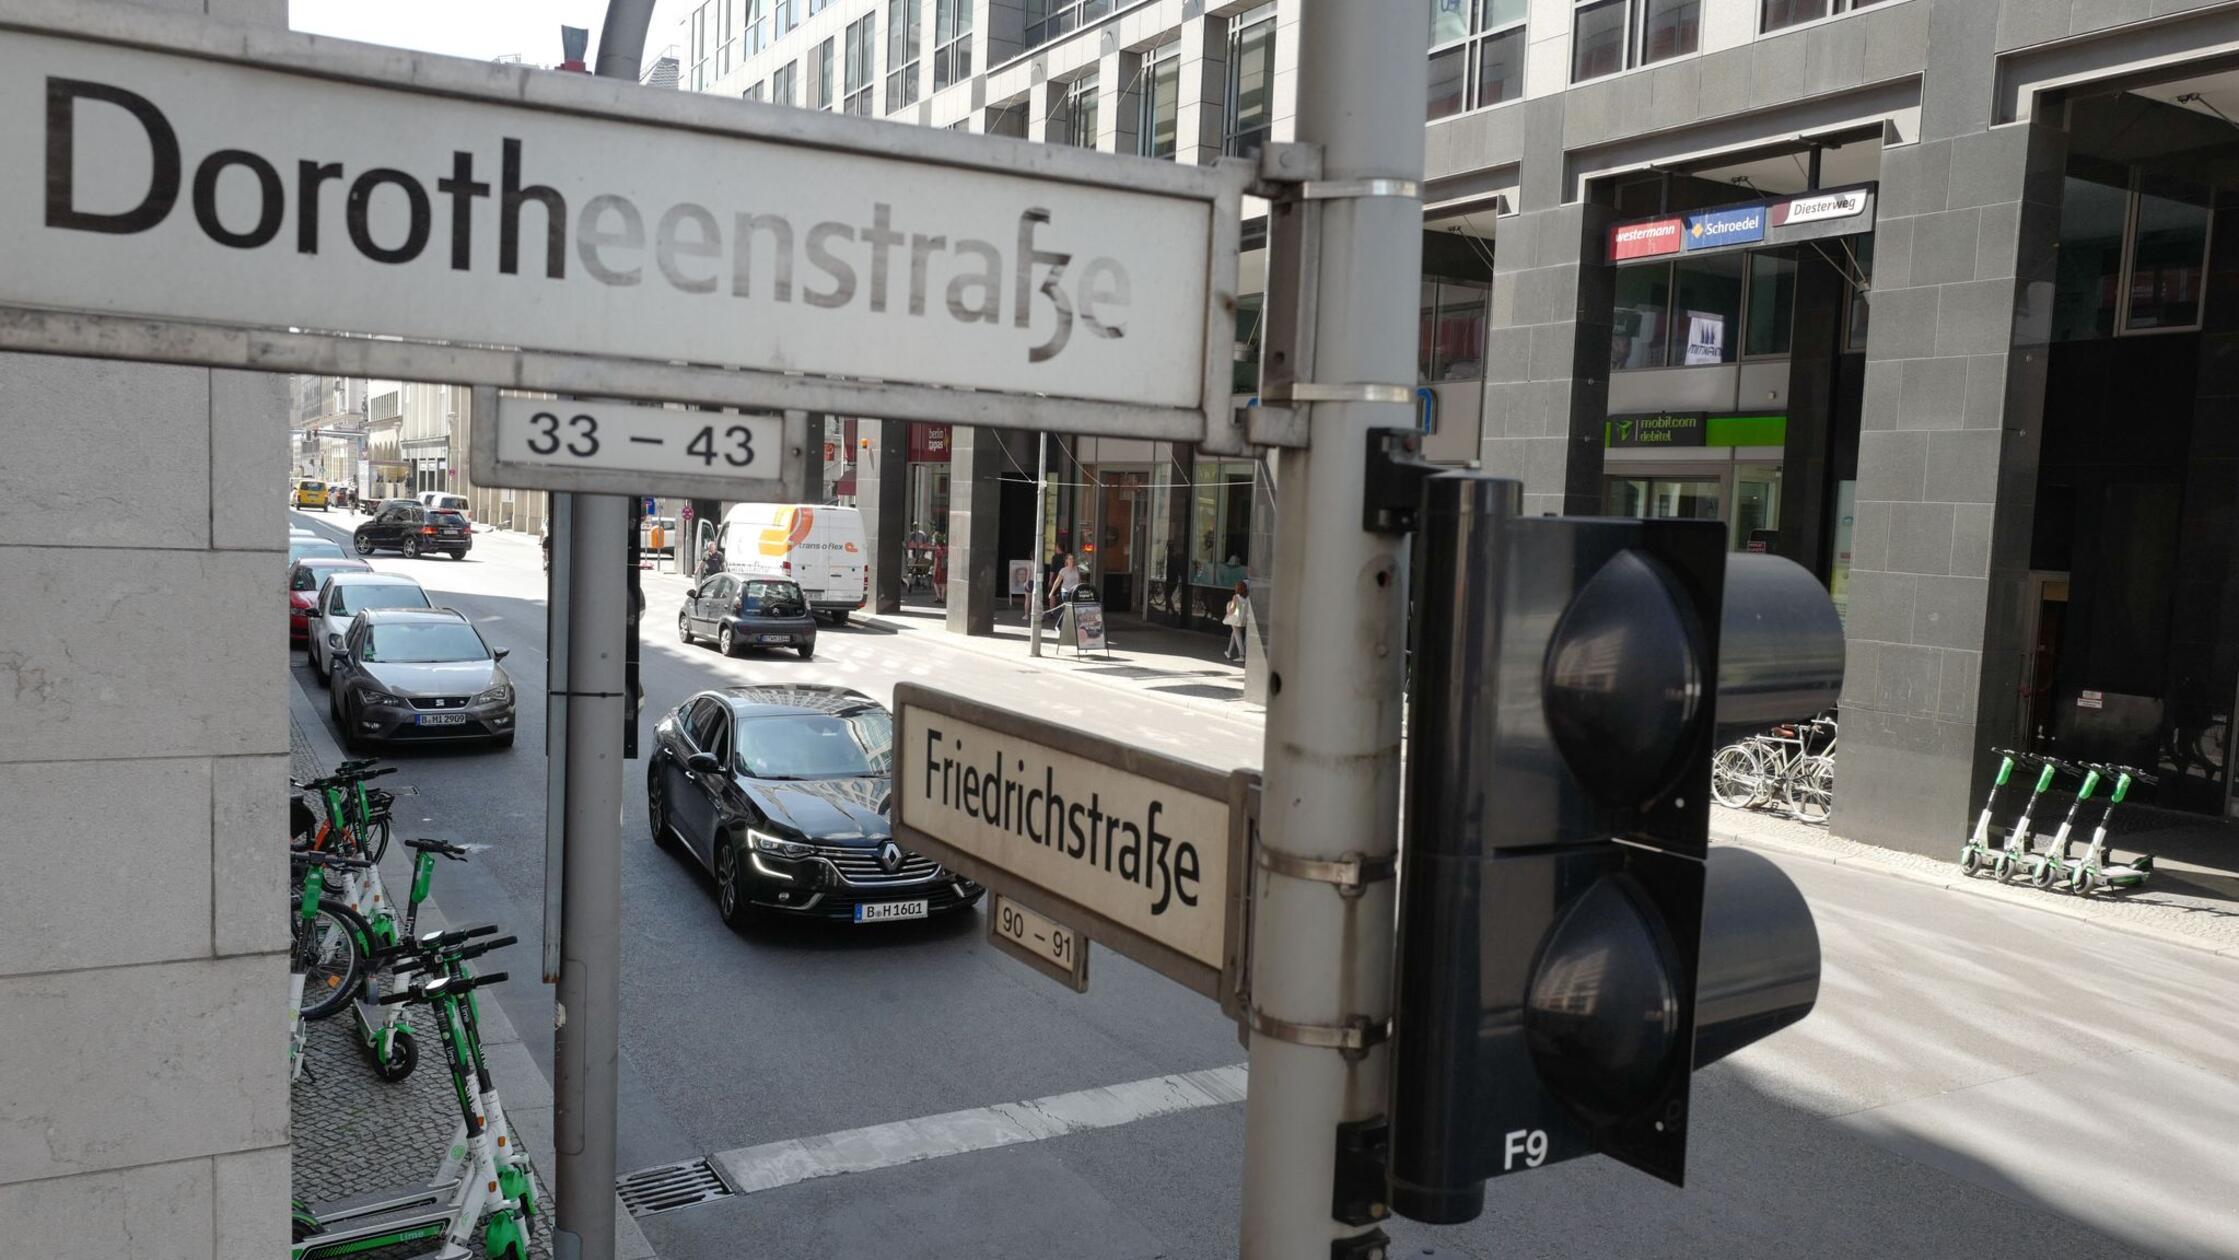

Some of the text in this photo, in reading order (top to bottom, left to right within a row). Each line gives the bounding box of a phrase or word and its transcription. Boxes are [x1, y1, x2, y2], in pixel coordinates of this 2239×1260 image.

[1793, 197, 1856, 216] Diesterweg
[45, 76, 1131, 363] Dorotheenstraße
[1705, 215, 1759, 235] Schroedel
[1615, 224, 1675, 242] westermann
[1640, 416, 1696, 429] mobilcom
[527, 412, 600, 457] 33
[686, 425, 755, 467] 43
[1640, 430, 1672, 442] debitel
[926, 728, 1200, 916] Friedrichstraße
[1002, 906, 1024, 938] 90
[1052, 930, 1071, 963] 91
[1504, 1128, 1548, 1170] F9
[400, 1230, 424, 1242] Lime
